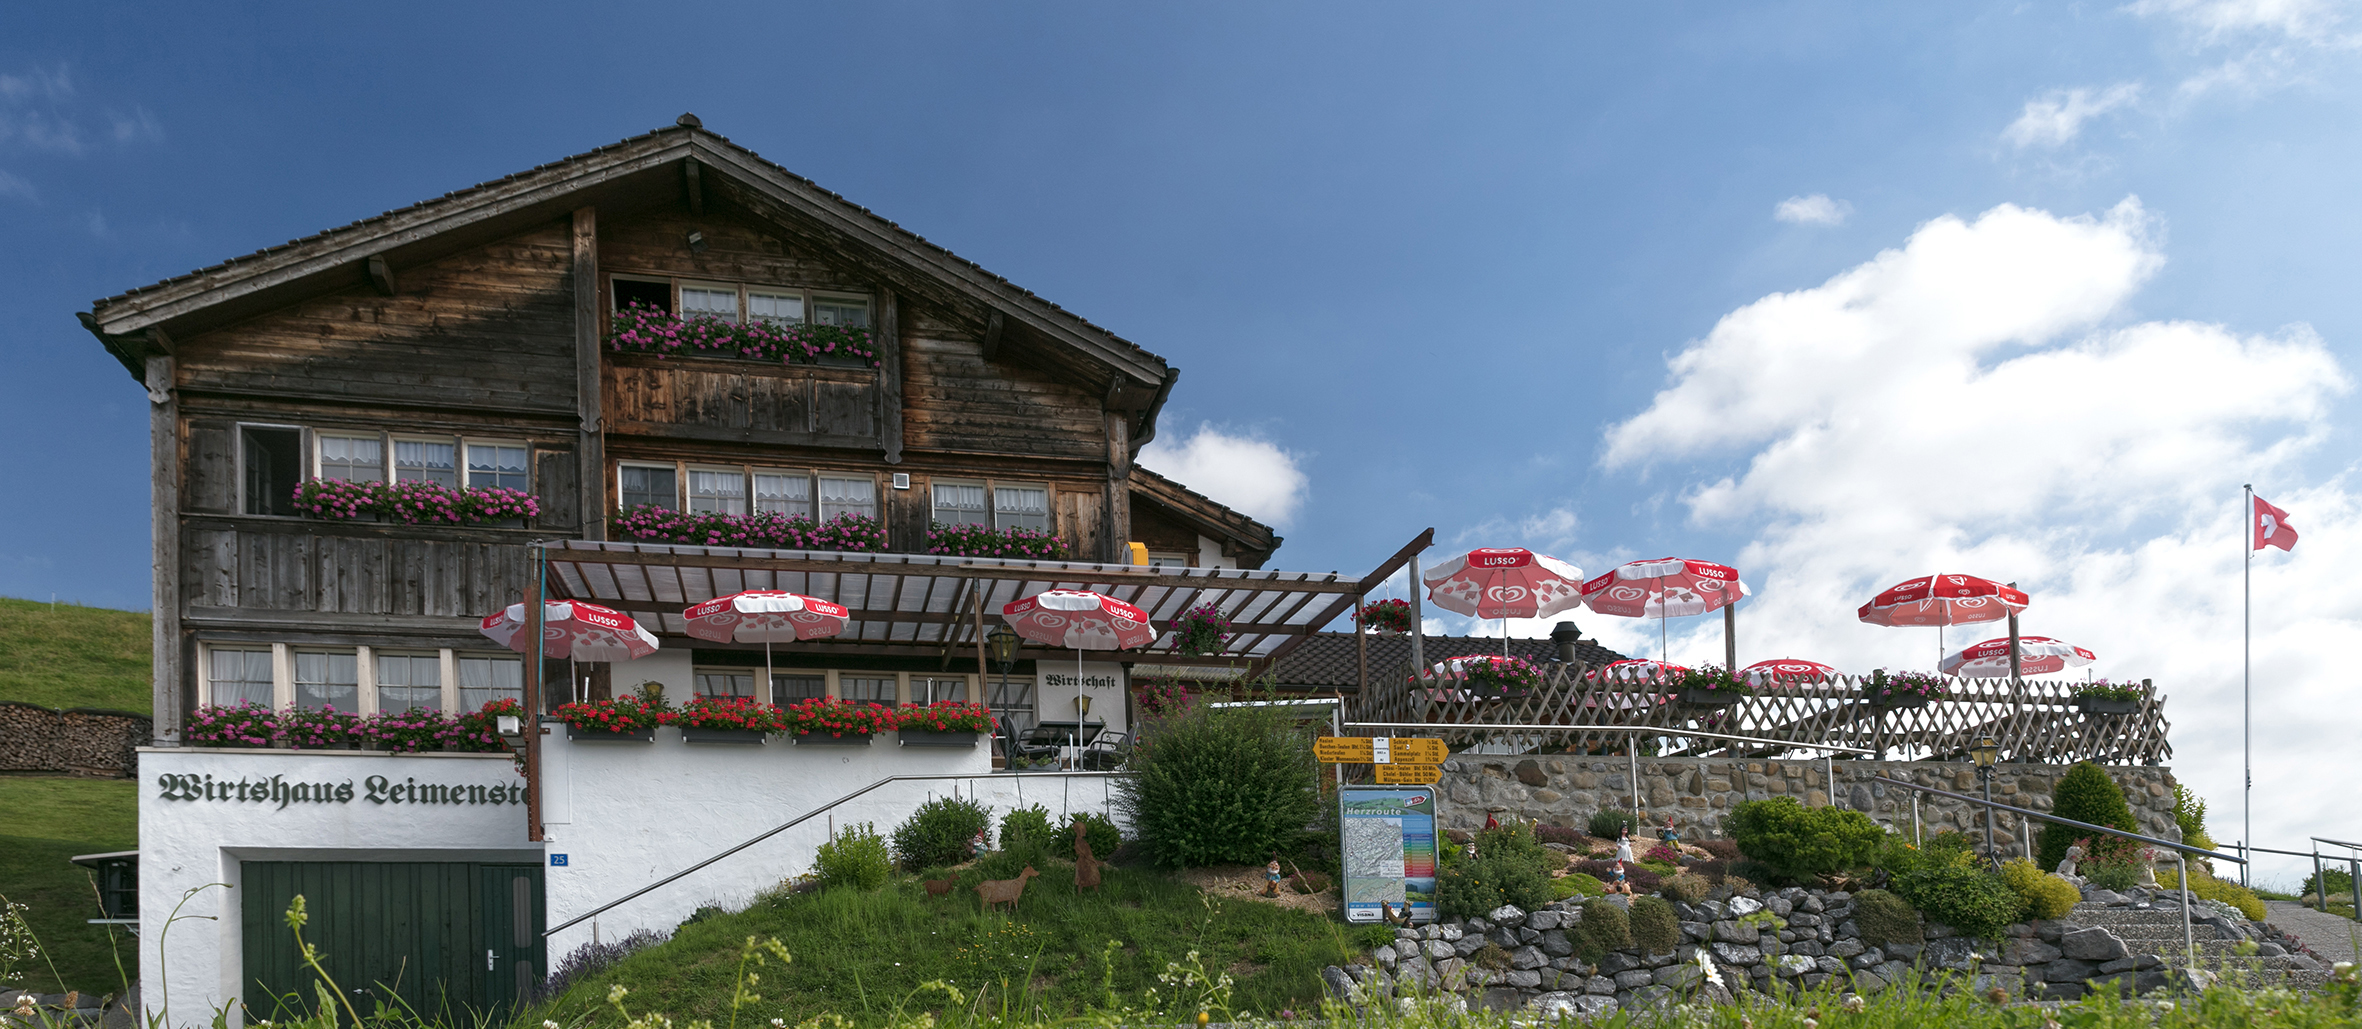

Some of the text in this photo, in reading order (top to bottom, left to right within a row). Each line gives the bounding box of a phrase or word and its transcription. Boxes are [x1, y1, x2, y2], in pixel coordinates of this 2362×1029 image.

[1484, 557, 1516, 566] LUSSO
[1698, 566, 1725, 578] LUSSO
[1589, 577, 1609, 591] LUSSO
[697, 604, 721, 616] LUSSO
[815, 603, 837, 614] LUSSO
[1014, 601, 1031, 613] LUSSO
[1110, 604, 1134, 619] LUSSO
[588, 613, 618, 627] LUSSO
[1978, 649, 2005, 658] LUSSO
[158, 773, 355, 812] Wirtshaus
[1346, 807, 1402, 815] Herzroute
[553, 856, 565, 864] 25
